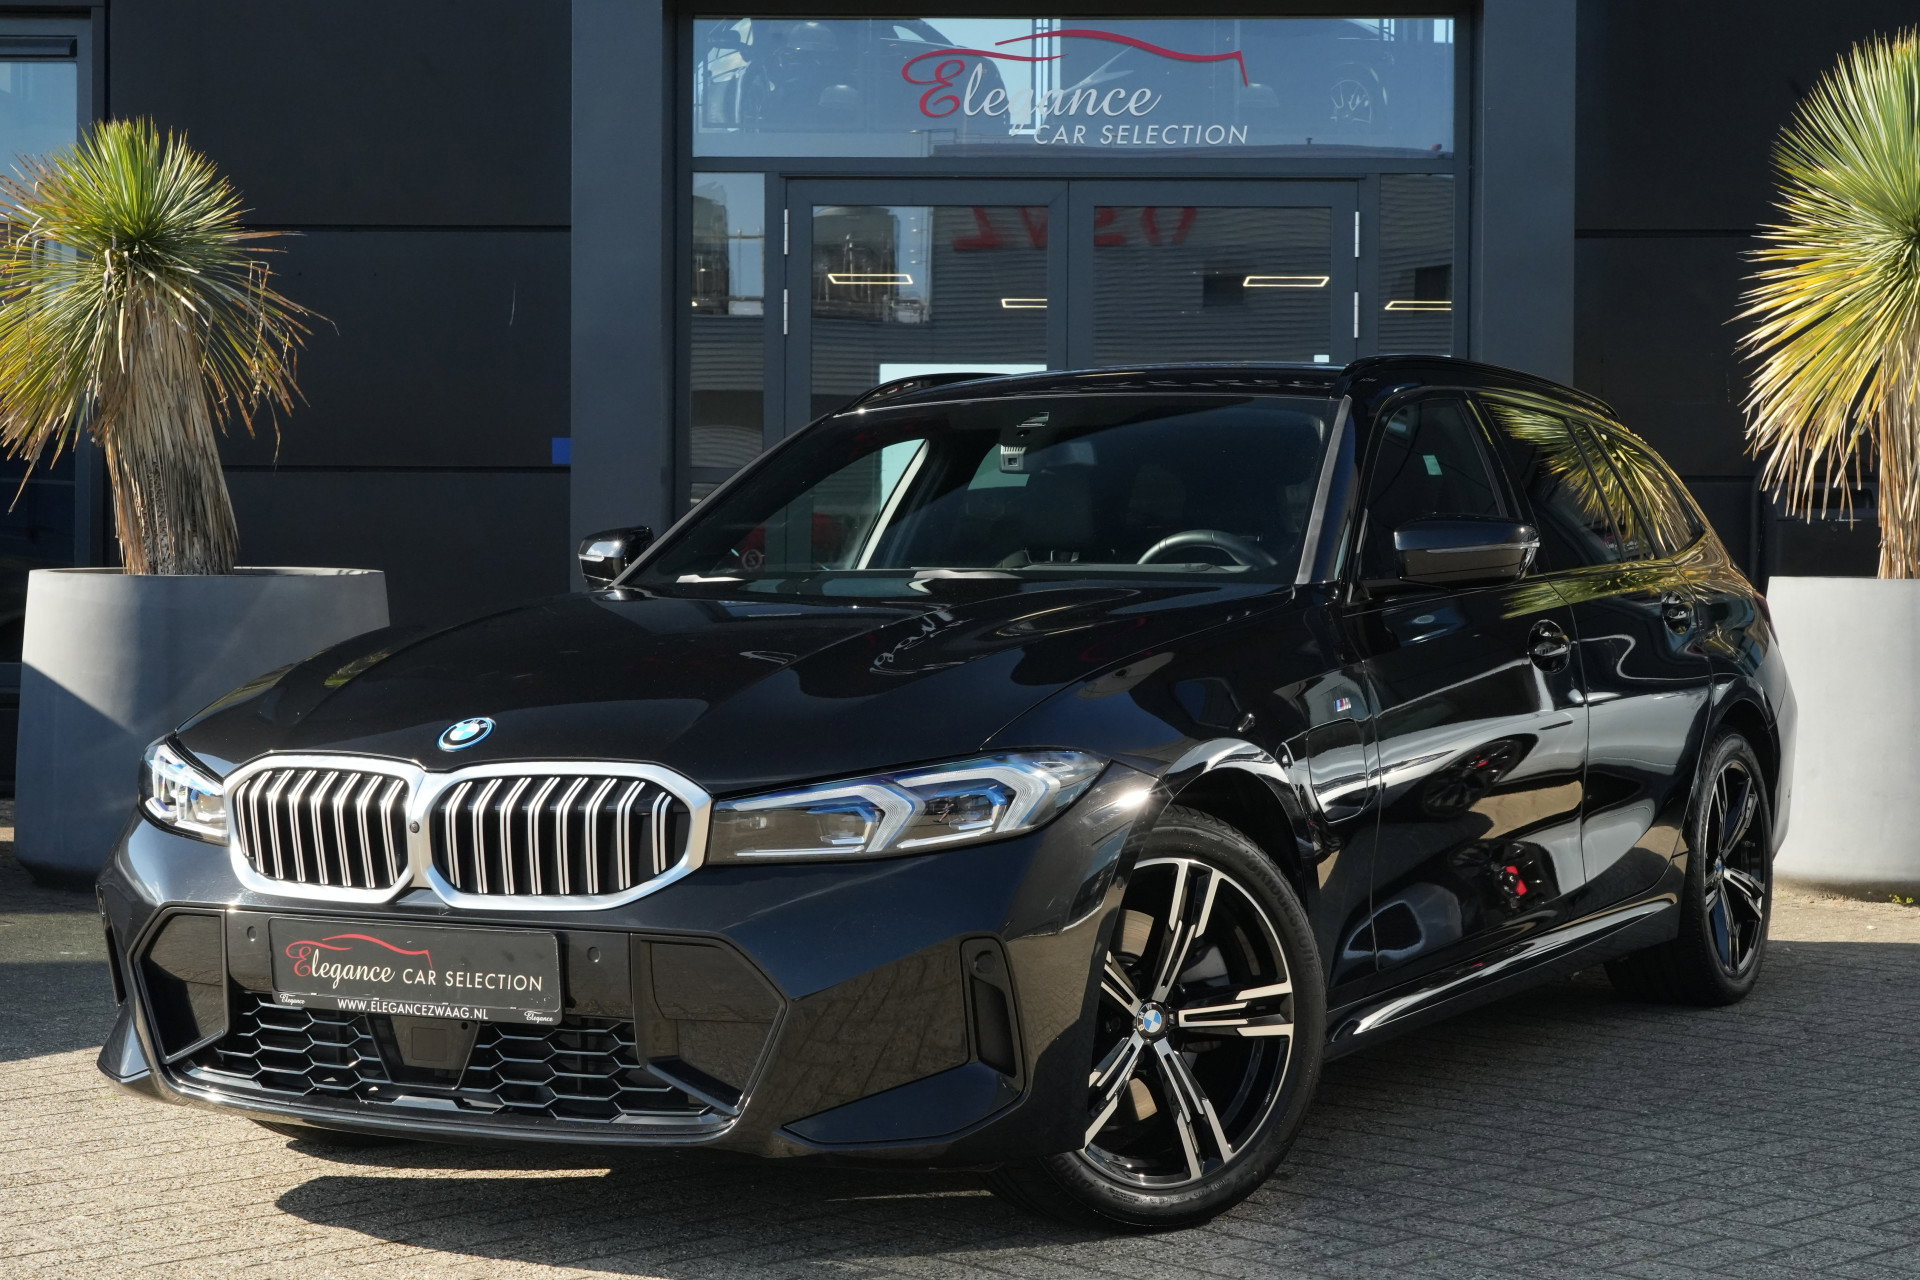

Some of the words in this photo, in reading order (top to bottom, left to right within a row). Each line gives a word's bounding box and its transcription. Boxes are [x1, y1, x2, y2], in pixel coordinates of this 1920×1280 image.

[902, 49, 1162, 137] Elegance
[1033, 124, 1085, 145] CAR
[1099, 124, 1249, 145] SELECTION
[285, 940, 396, 990] Elegance
[402, 968, 437, 986] CAR
[444, 971, 543, 992] SELECTION
[337, 998, 489, 1020] WWW.ELEGANCEZWAAG.NL
